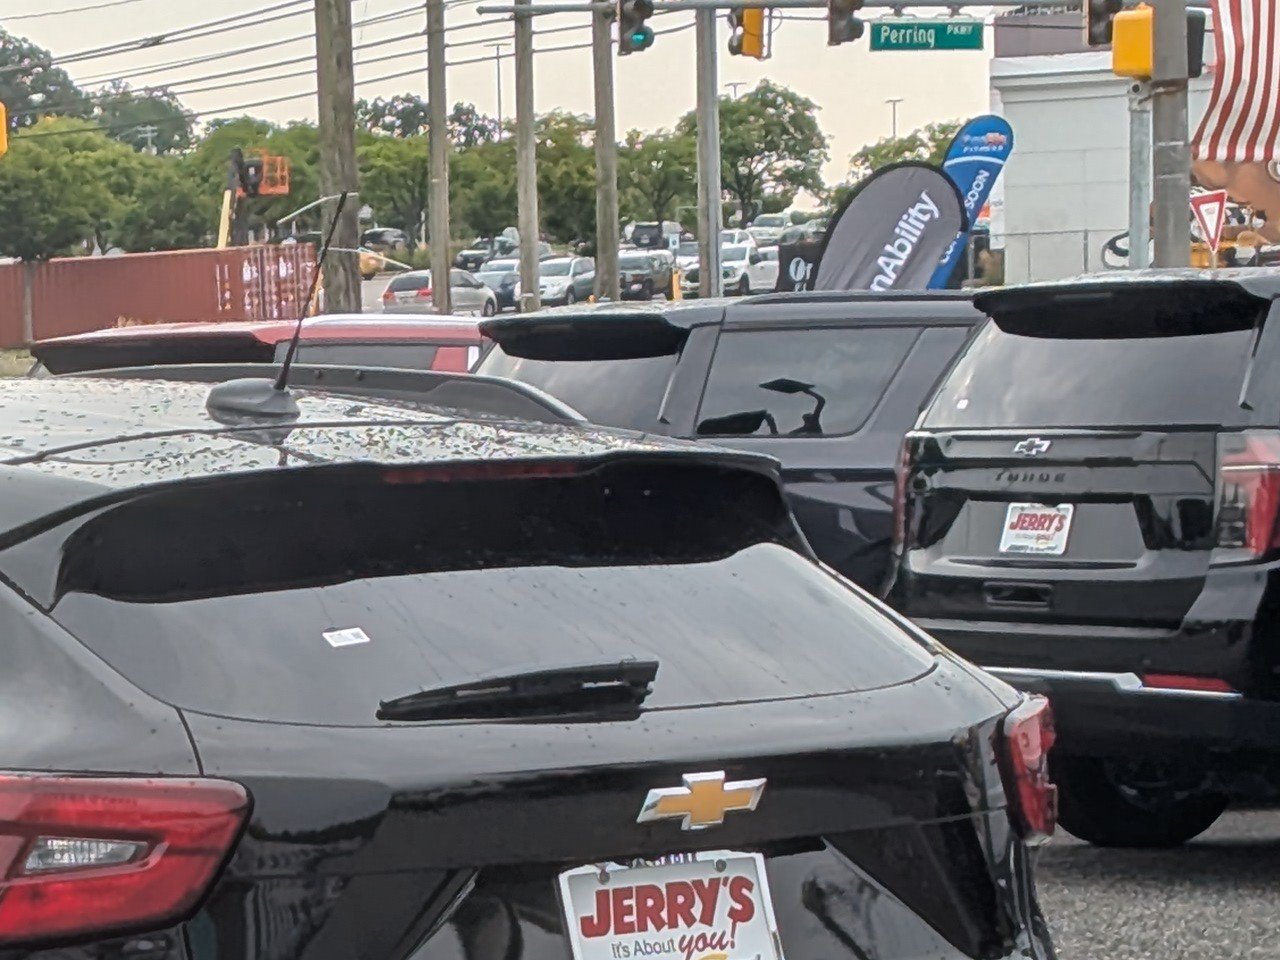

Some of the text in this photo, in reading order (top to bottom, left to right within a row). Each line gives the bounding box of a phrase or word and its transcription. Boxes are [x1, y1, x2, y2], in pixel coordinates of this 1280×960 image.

[880, 25, 935, 48] Perring
[964, 169, 991, 209] SOON
[1009, 513, 1067, 532] JERRY'S
[580, 875, 755, 938] JERRY'S
[634, 937, 676, 955] About
